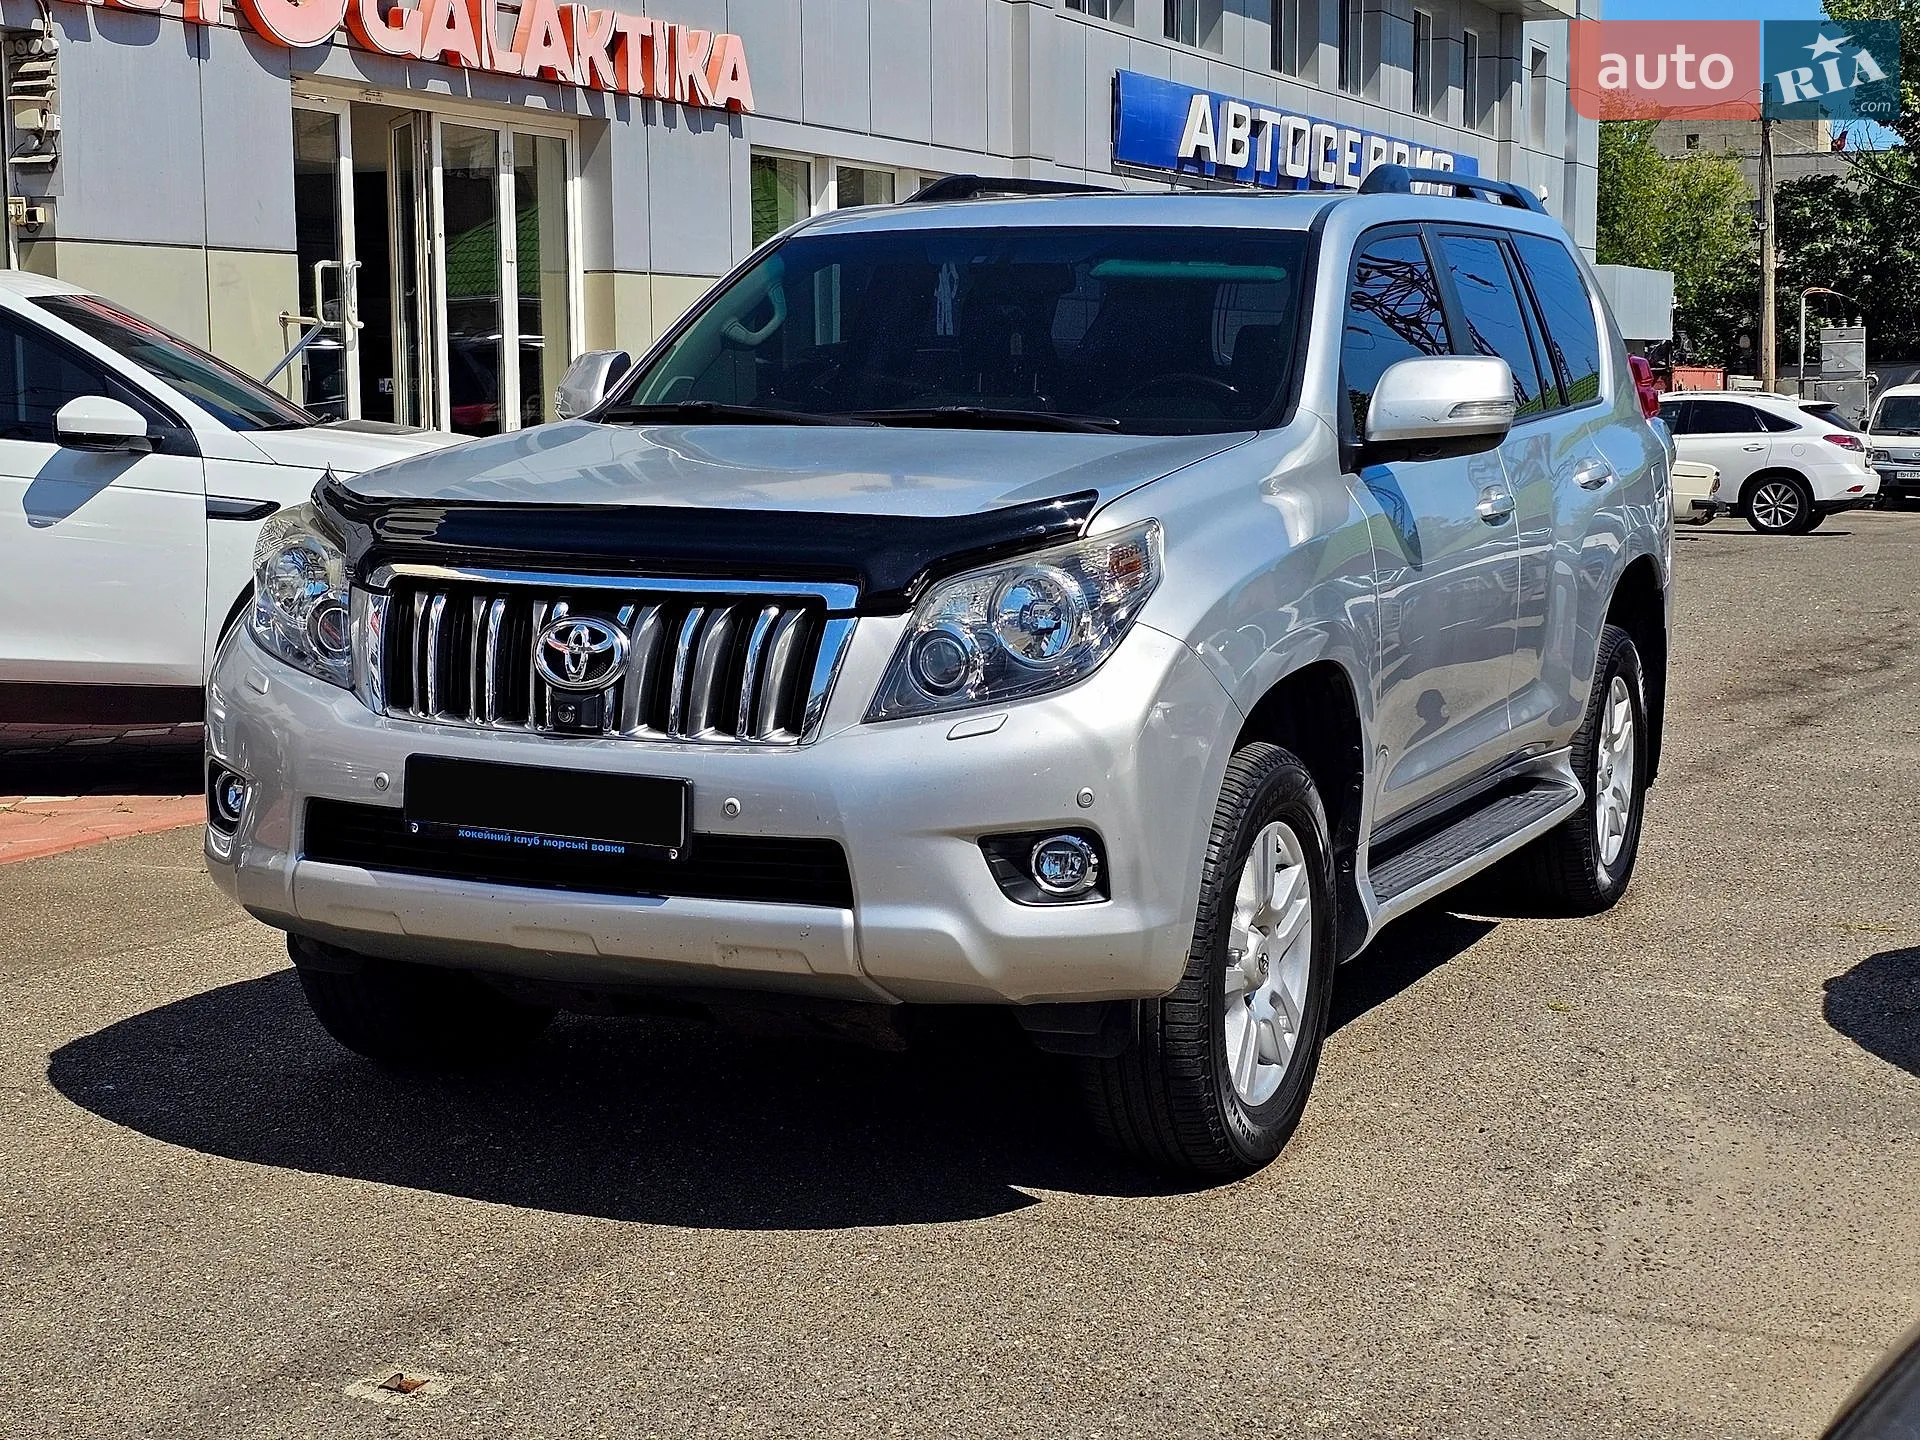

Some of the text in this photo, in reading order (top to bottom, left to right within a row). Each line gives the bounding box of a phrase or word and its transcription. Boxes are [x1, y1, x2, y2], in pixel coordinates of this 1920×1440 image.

[458, 829, 625, 854] хокейний клуб морські вовки
